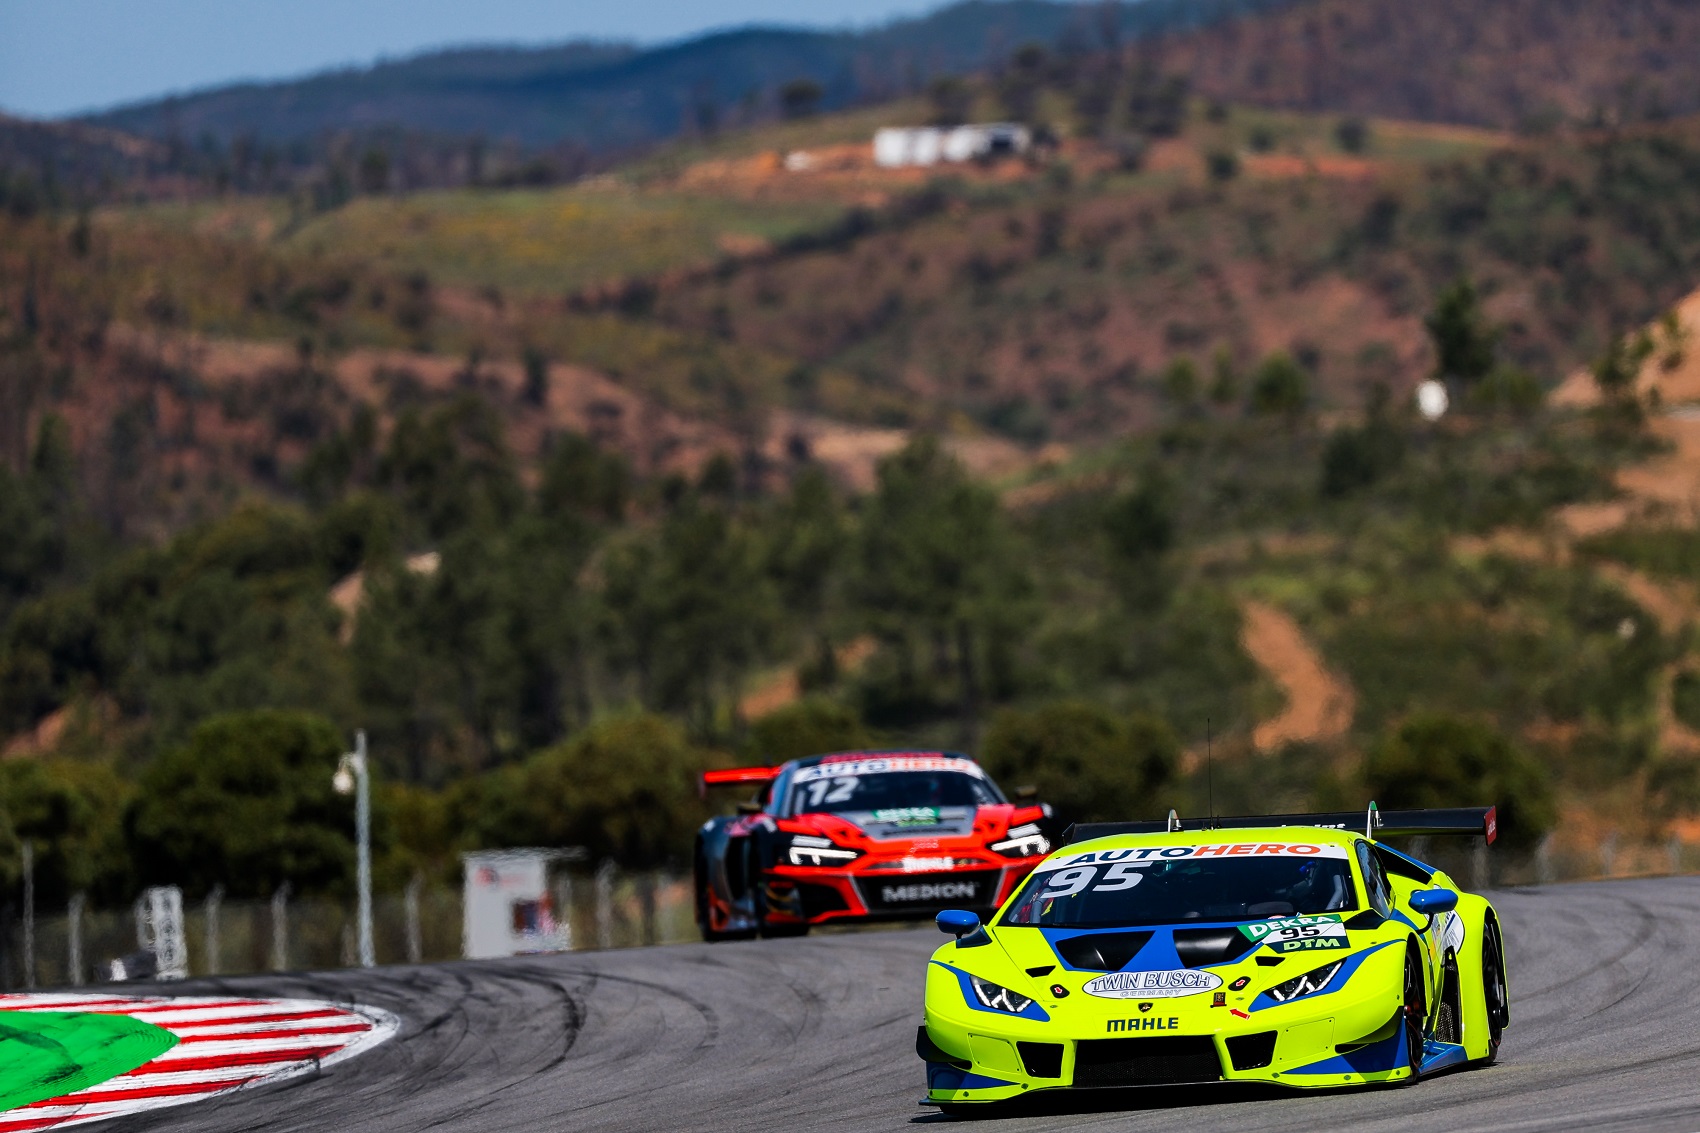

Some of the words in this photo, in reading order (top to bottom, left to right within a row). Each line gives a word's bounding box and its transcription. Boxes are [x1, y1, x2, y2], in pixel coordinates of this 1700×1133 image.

[807, 776, 860, 806] 12
[1063, 844, 1322, 867] AUTOHERO
[1040, 861, 1153, 898] 95
[882, 882, 976, 902] MEDION
[1247, 916, 1336, 938] DEKRA
[1280, 925, 1320, 940] 95
[1283, 938, 1341, 951] DTM
[1090, 972, 1141, 991] TWIN
[1143, 971, 1212, 989] BUSCH
[1119, 988, 1182, 998] GERMANY
[1106, 1017, 1179, 1033] MAHLE
